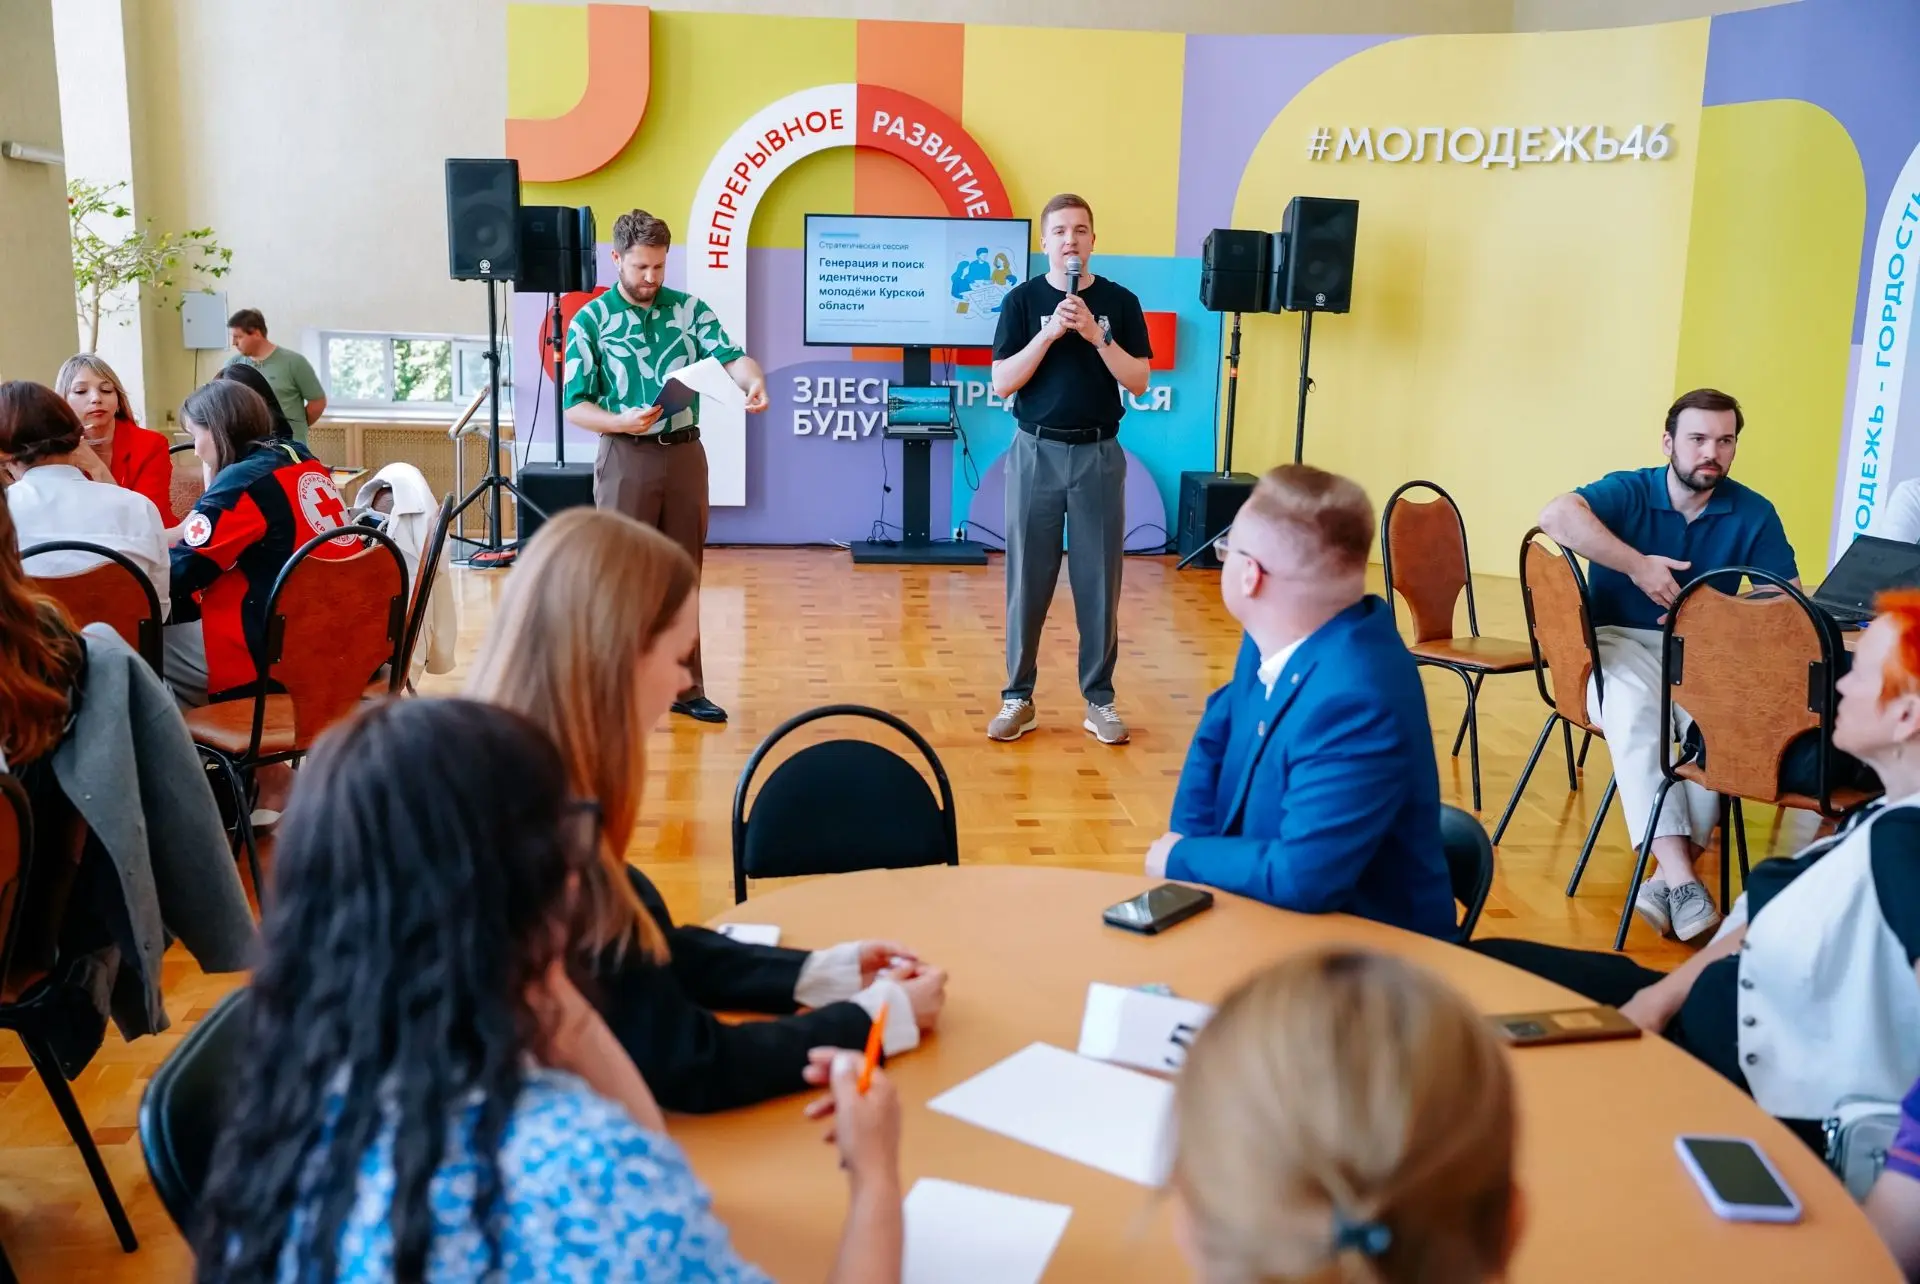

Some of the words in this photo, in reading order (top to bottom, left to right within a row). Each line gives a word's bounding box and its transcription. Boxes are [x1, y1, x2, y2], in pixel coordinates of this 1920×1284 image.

[1307, 124, 1669, 169] #МОЛОДЕЖЬ46
[708, 108, 844, 269] НЕПРЕРЫВНОЕ
[872, 110, 990, 218] РАЗВИТИЕ
[819, 241, 880, 250] Стратегическая
[819, 258, 878, 269] Генерация
[892, 261, 925, 269] поиск
[819, 274, 898, 283] идентичности
[819, 288, 876, 297] молодёжи
[879, 288, 925, 299] Курской
[819, 301, 865, 311] области
[793, 409, 888, 441] БУДУ
[1853, 404, 1885, 541] ОДЕЖЬ
